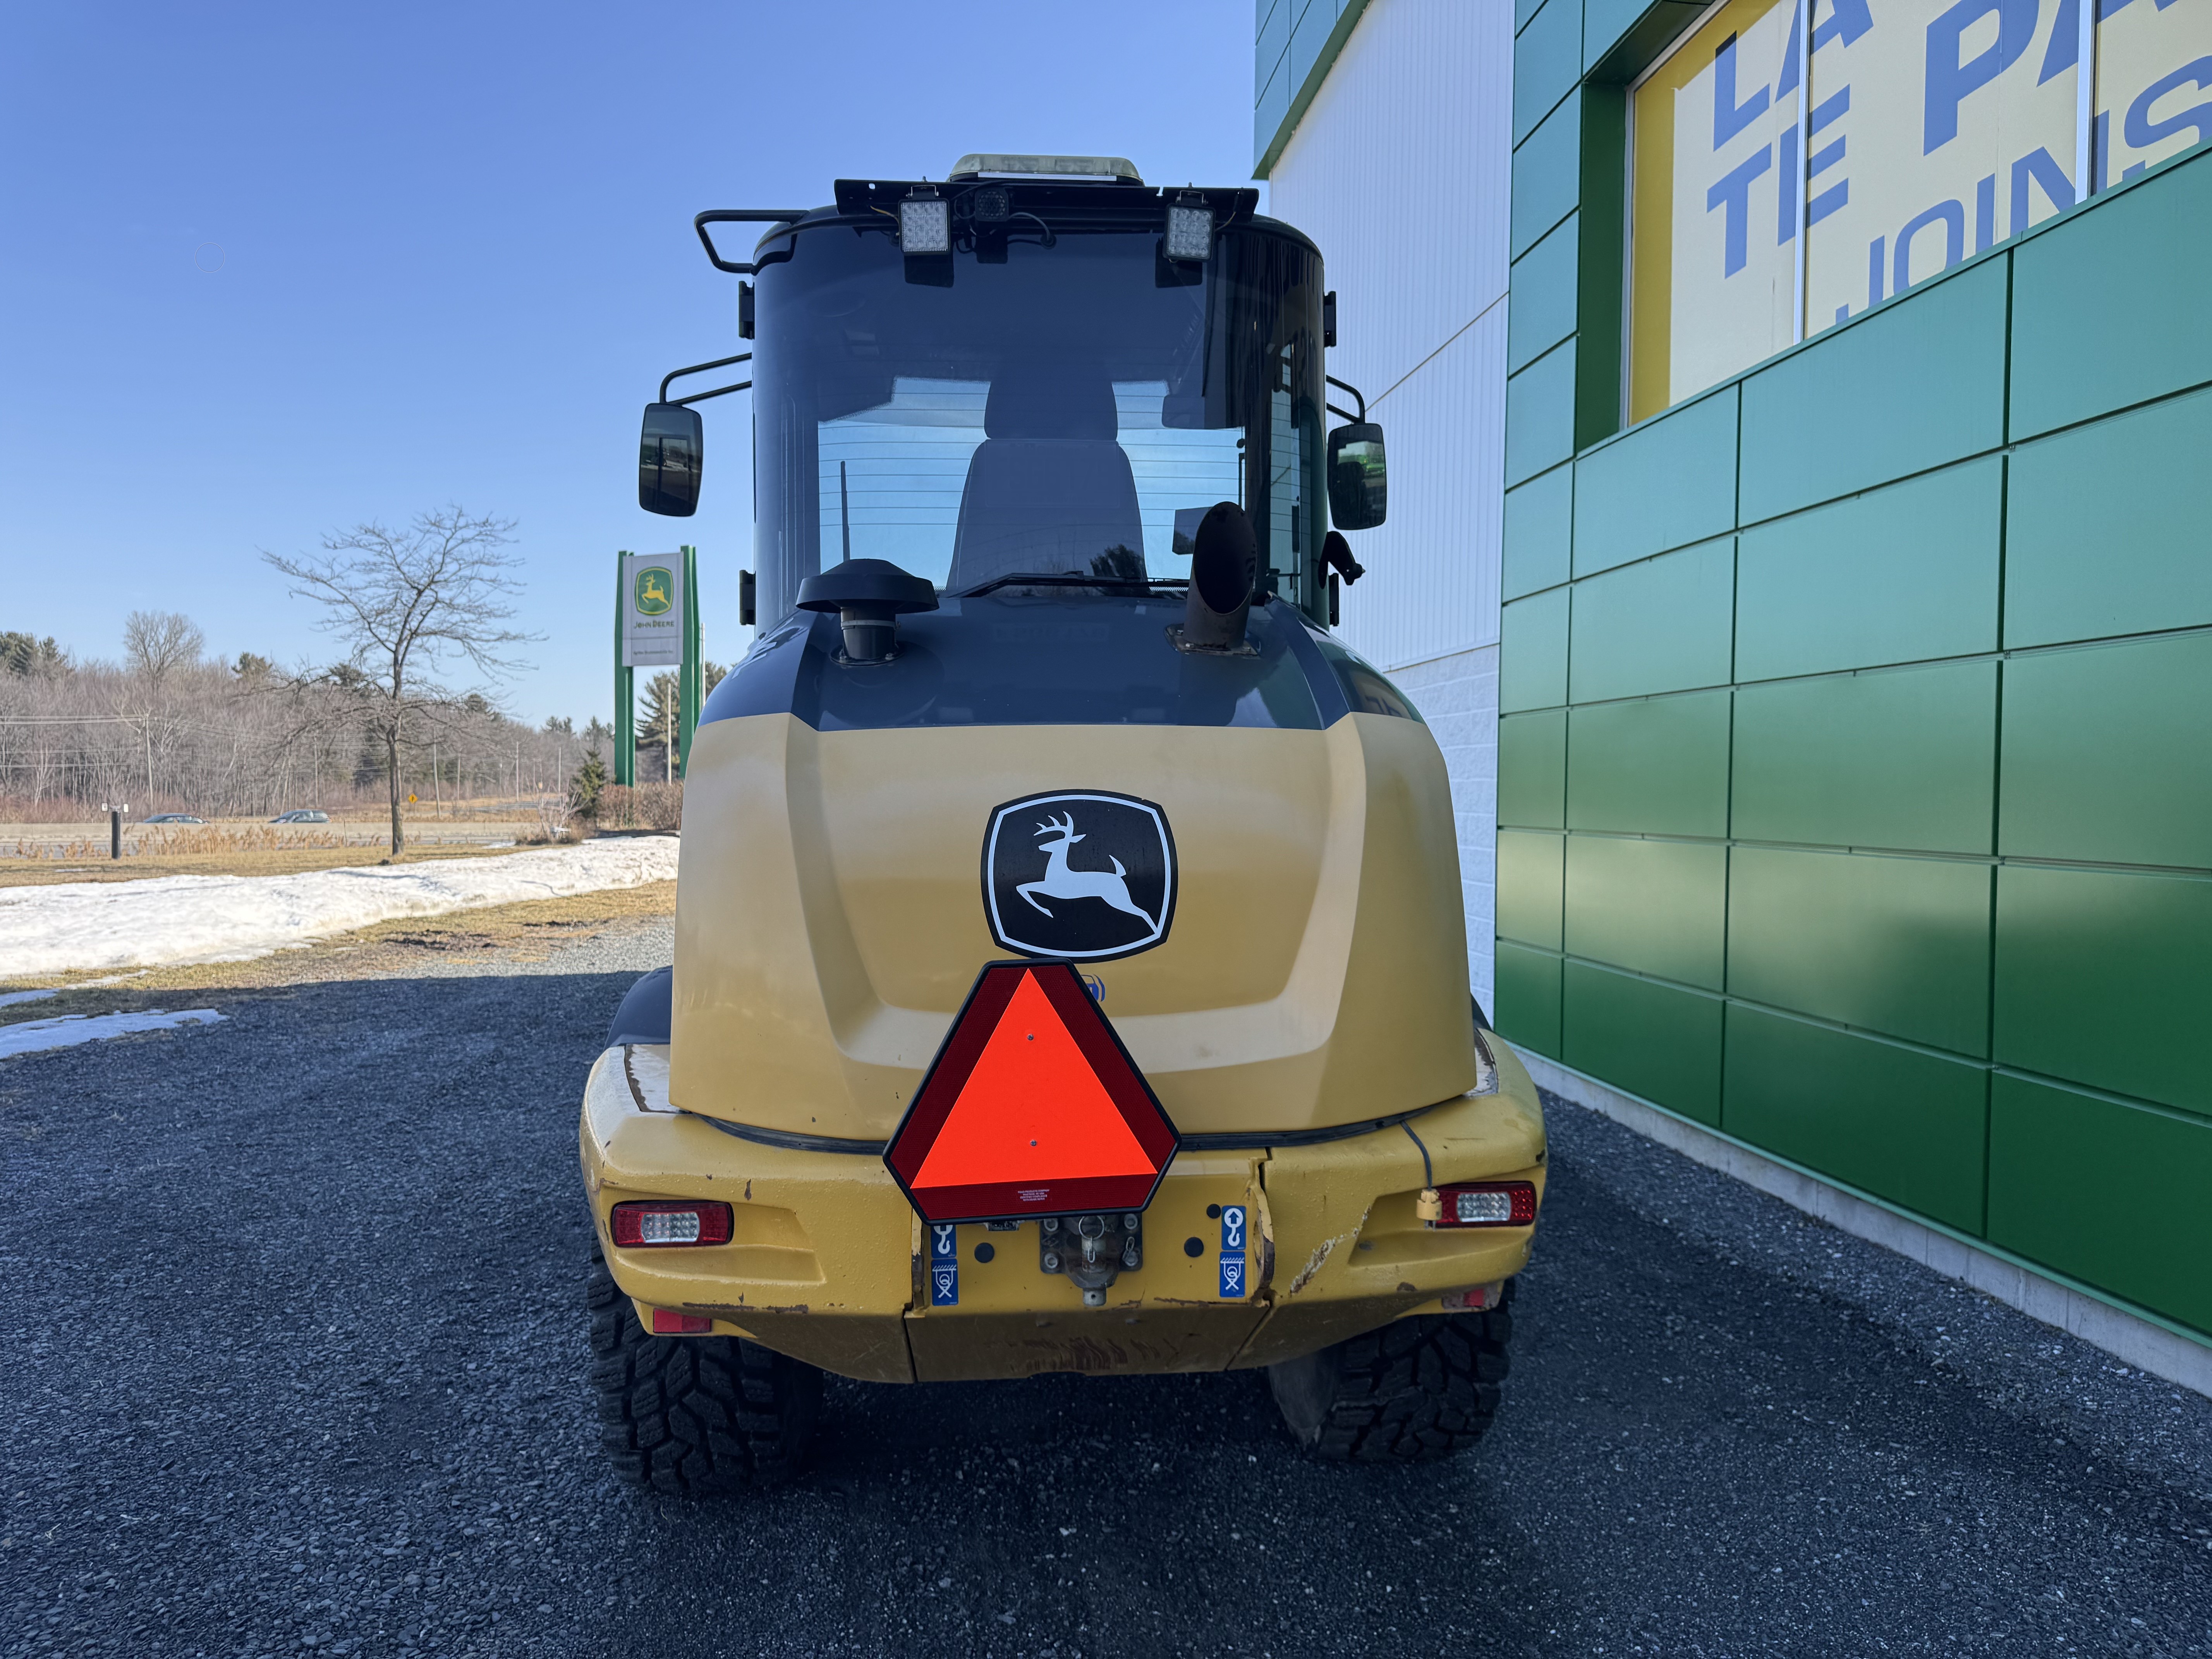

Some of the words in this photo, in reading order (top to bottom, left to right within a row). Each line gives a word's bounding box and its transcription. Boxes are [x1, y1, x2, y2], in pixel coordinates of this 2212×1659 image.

[1714, 0, 1874, 152] LA
[1707, 84, 1850, 279] TE
[634, 621, 651, 629] JOHN
[653, 619, 675, 628] DEERE
